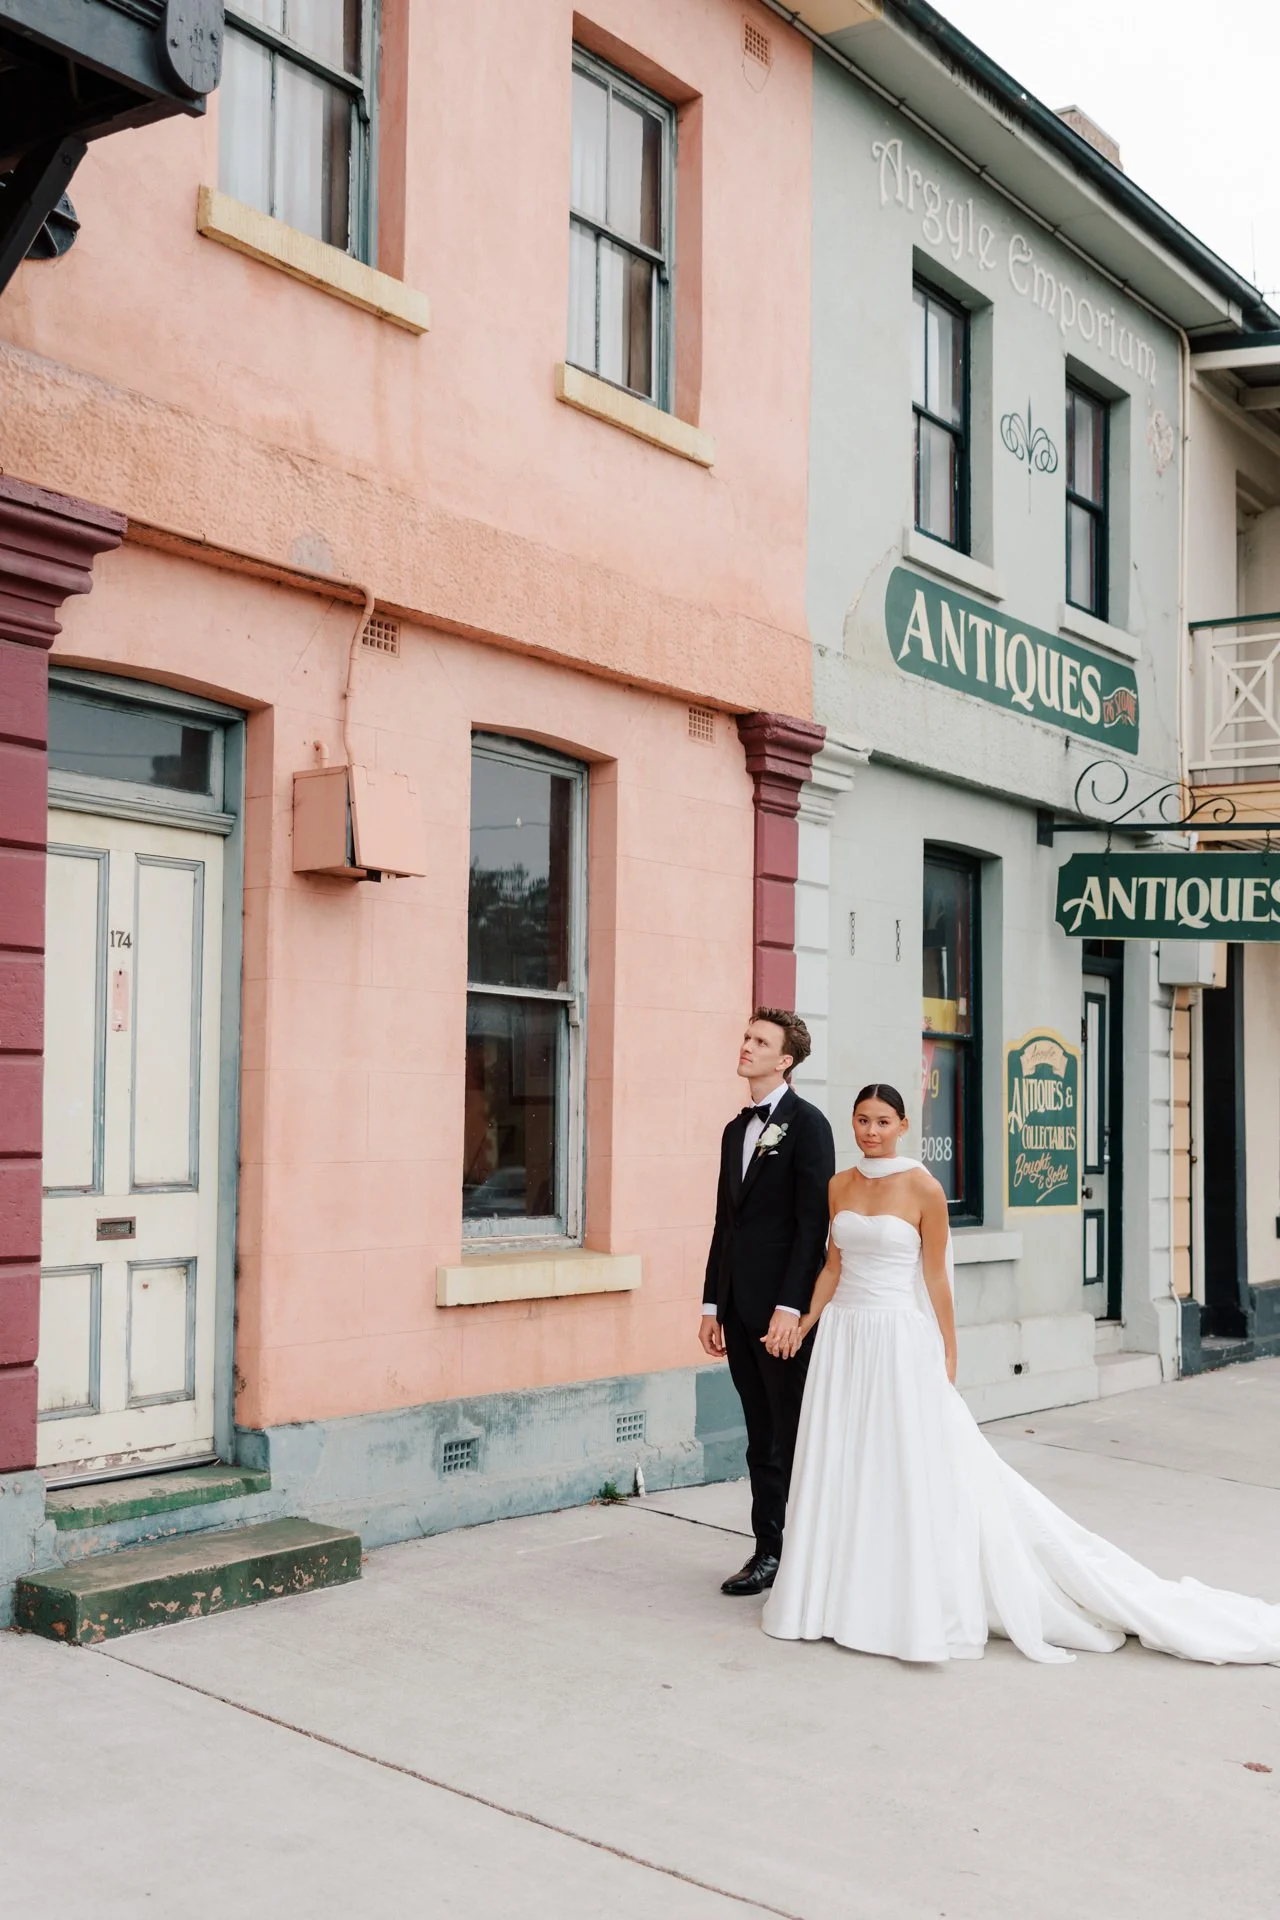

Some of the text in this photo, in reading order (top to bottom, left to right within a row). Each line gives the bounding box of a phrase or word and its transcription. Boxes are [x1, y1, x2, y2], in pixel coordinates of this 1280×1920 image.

[871, 138, 1157, 386] Argyle Emporium
[897, 588, 1101, 724] ANTIQUES
[110, 930, 132, 948] 174
[1008, 1077, 1074, 1134] ANTIQUES &
[1021, 1124, 1076, 1150] COLLECTABLES
[1014, 1152, 1052, 1187] Bought
[1045, 1164, 1069, 1188] Sold
